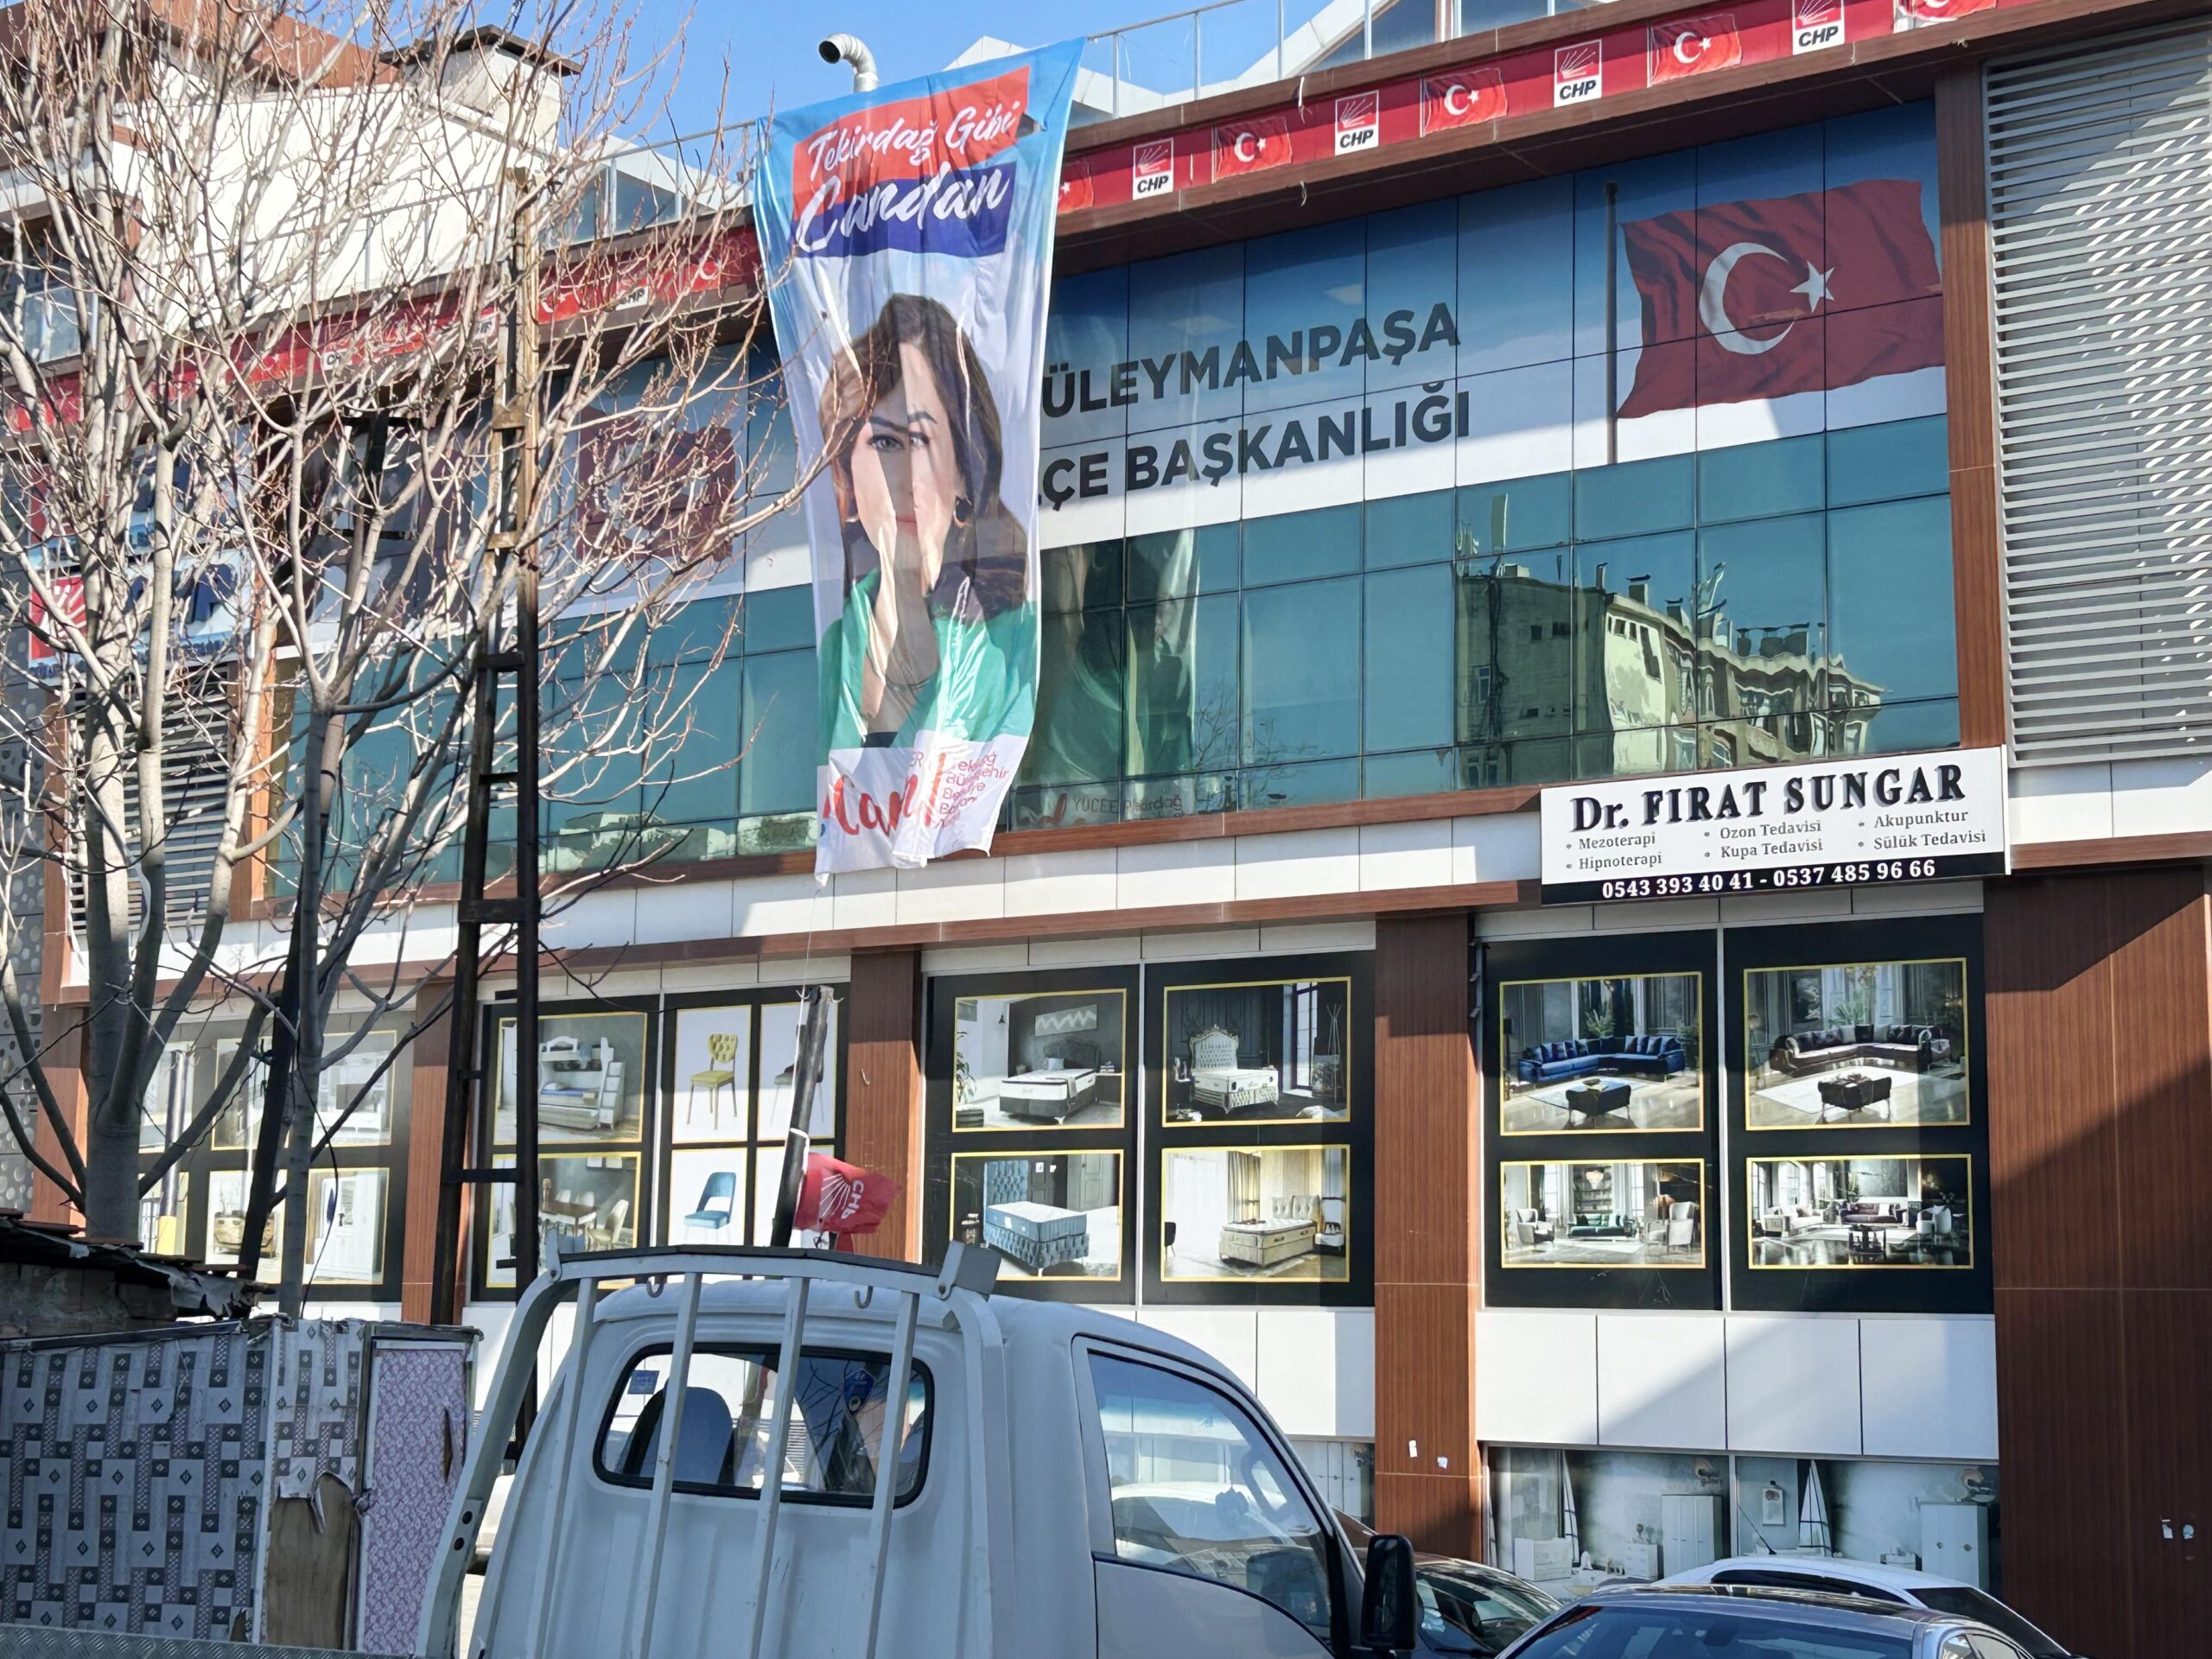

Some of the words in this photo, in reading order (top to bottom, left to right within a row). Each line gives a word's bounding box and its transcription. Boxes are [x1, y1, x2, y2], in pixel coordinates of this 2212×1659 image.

[1797, 25, 1840, 48] CHP
[1559, 79, 1597, 100] CHP
[807, 118, 938, 181] Tekirdağ
[945, 100, 1020, 156] Gibi
[1339, 129, 1374, 149] CHP
[1137, 175, 1170, 194] CHP
[795, 161, 1011, 253] Candan
[1041, 302, 1461, 418] ÜLEYMANPAŞA
[1038, 452, 1109, 512] ÇE
[1127, 378, 1470, 488] BAŞKANLIĞI
[1570, 797, 1629, 832] Dr.
[1642, 781, 1767, 825] FIRAT
[1783, 764, 1966, 815] SUNGAR
[1720, 826, 1756, 839] Ozon
[1760, 819, 1821, 836] Tedavisi
[1873, 810, 1969, 830] Akupunktur
[1579, 831, 1656, 849] Mezoterapi
[1720, 844, 1758, 860] Kupa
[1762, 837, 1823, 855] Tedavisi
[1873, 835, 1917, 850] Sülük
[1921, 830, 1986, 847] Tedavisi
[1579, 851, 1662, 872] Hipnoterapi
[1602, 879, 1650, 899] 0543
[1656, 876, 1693, 894] 393
[1698, 874, 1724, 892] 40
[1729, 872, 1754, 890] 41
[1773, 867, 1825, 887] 0537
[1831, 863, 1870, 883] 485
[1877, 861, 1903, 880] 96
[1910, 859, 1936, 877] 66
